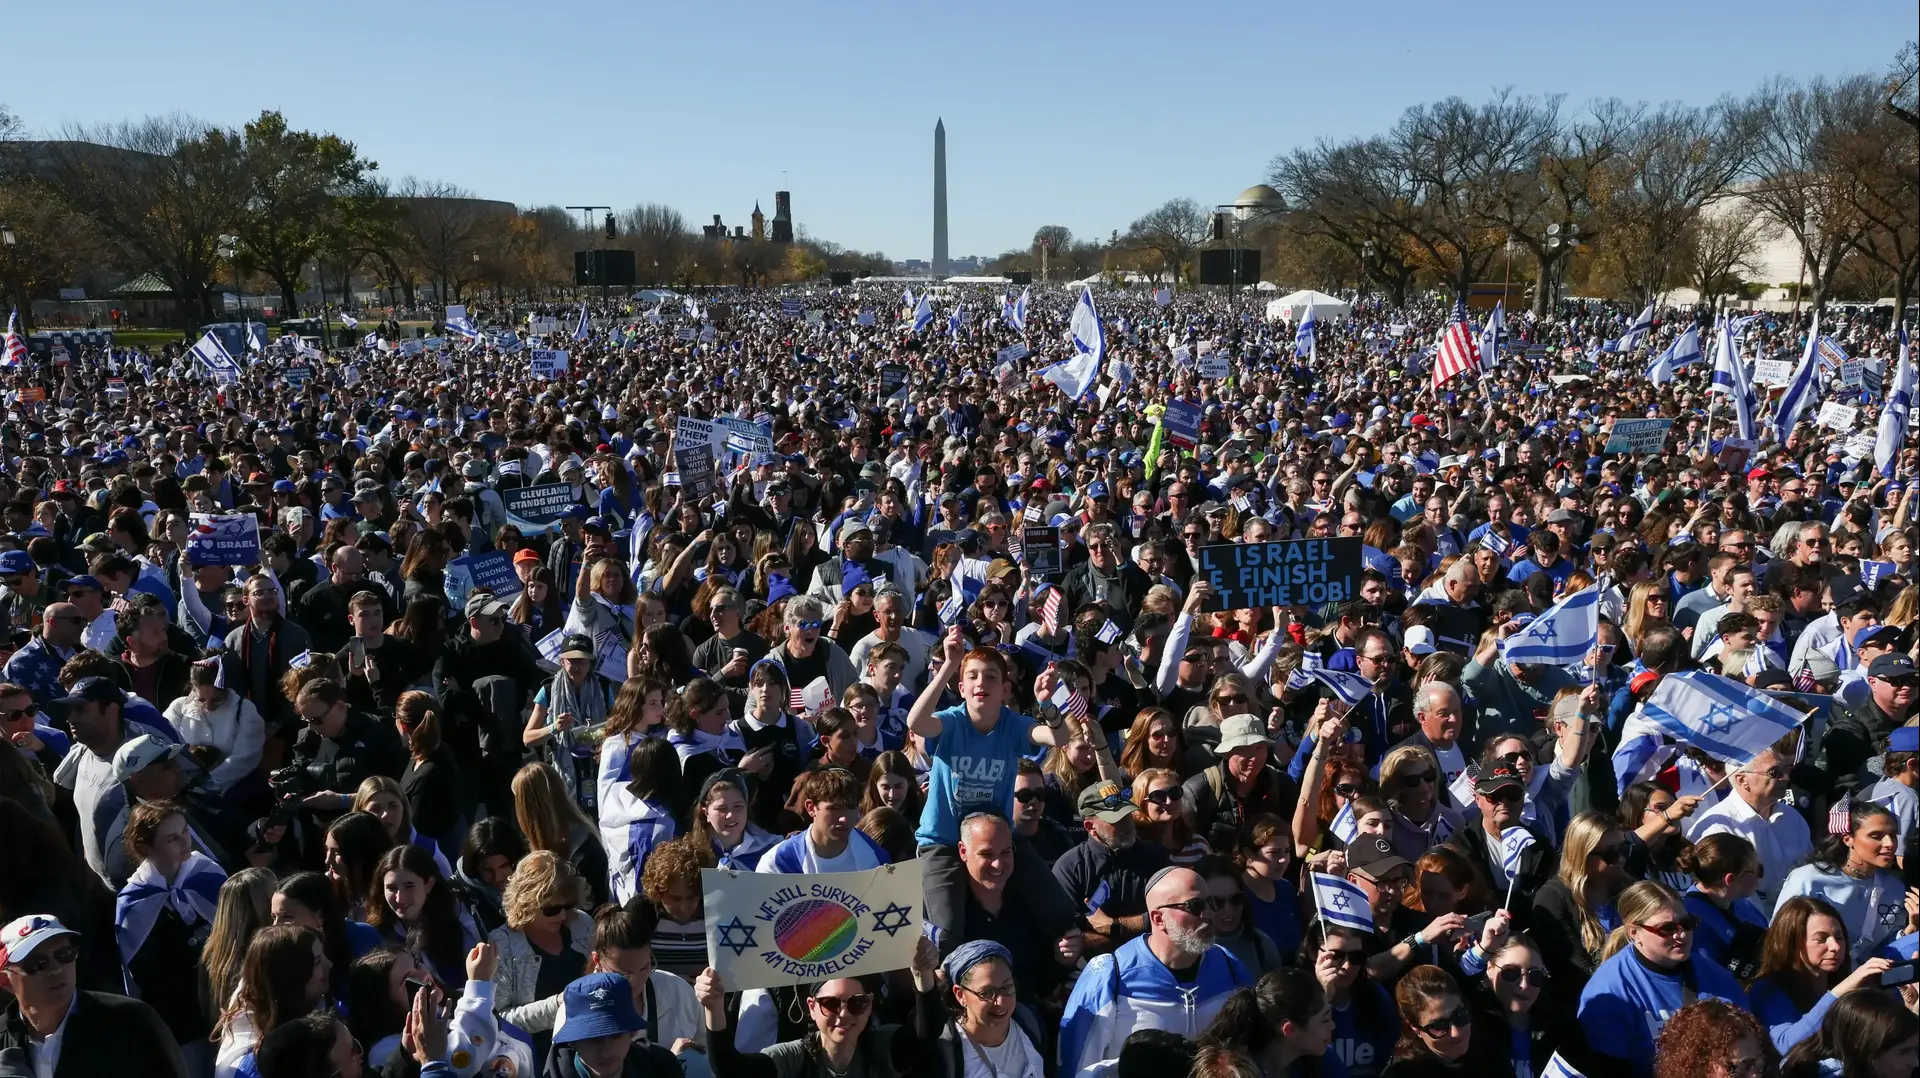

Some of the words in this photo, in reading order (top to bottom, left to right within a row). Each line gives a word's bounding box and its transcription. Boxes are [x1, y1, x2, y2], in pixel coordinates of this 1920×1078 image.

[532, 351, 556, 360] BRING
[534, 360, 554, 368] THEM
[1843, 360, 1866, 369] PHILLY
[679, 419, 713, 433] BRING
[727, 419, 764, 436] CLEVELAND
[1617, 420, 1662, 432] CLEVELAND
[678, 428, 708, 442] THEM
[1628, 430, 1663, 440] STRONGER
[1626, 440, 1644, 448] THAN
[1645, 437, 1662, 445] HATE
[688, 447, 700, 455] WE
[684, 453, 707, 463] STAND
[687, 460, 706, 469] WITH
[685, 466, 710, 475] ISRAEL
[520, 486, 570, 499] CLEVELAND
[509, 498, 547, 510] STANDS
[547, 495, 570, 506] WITH
[187, 539, 199, 548] DC
[216, 539, 255, 548] ISRAEL
[1235, 540, 1335, 568] ISRAEL
[474, 556, 505, 570] BOSTON
[476, 565, 510, 580] STRONG.
[1239, 562, 1327, 589] FINISH
[1867, 564, 1880, 591] SRAEL
[1243, 584, 1291, 608] THE
[1297, 574, 1352, 604] JOB!
[755, 901, 779, 922] WE
[772, 884, 807, 912] WILL
[810, 883, 872, 918] SURVIVE
[760, 949, 784, 970] AM
[782, 957, 844, 978] YISRAEL
[840, 936, 876, 968] CHAI
